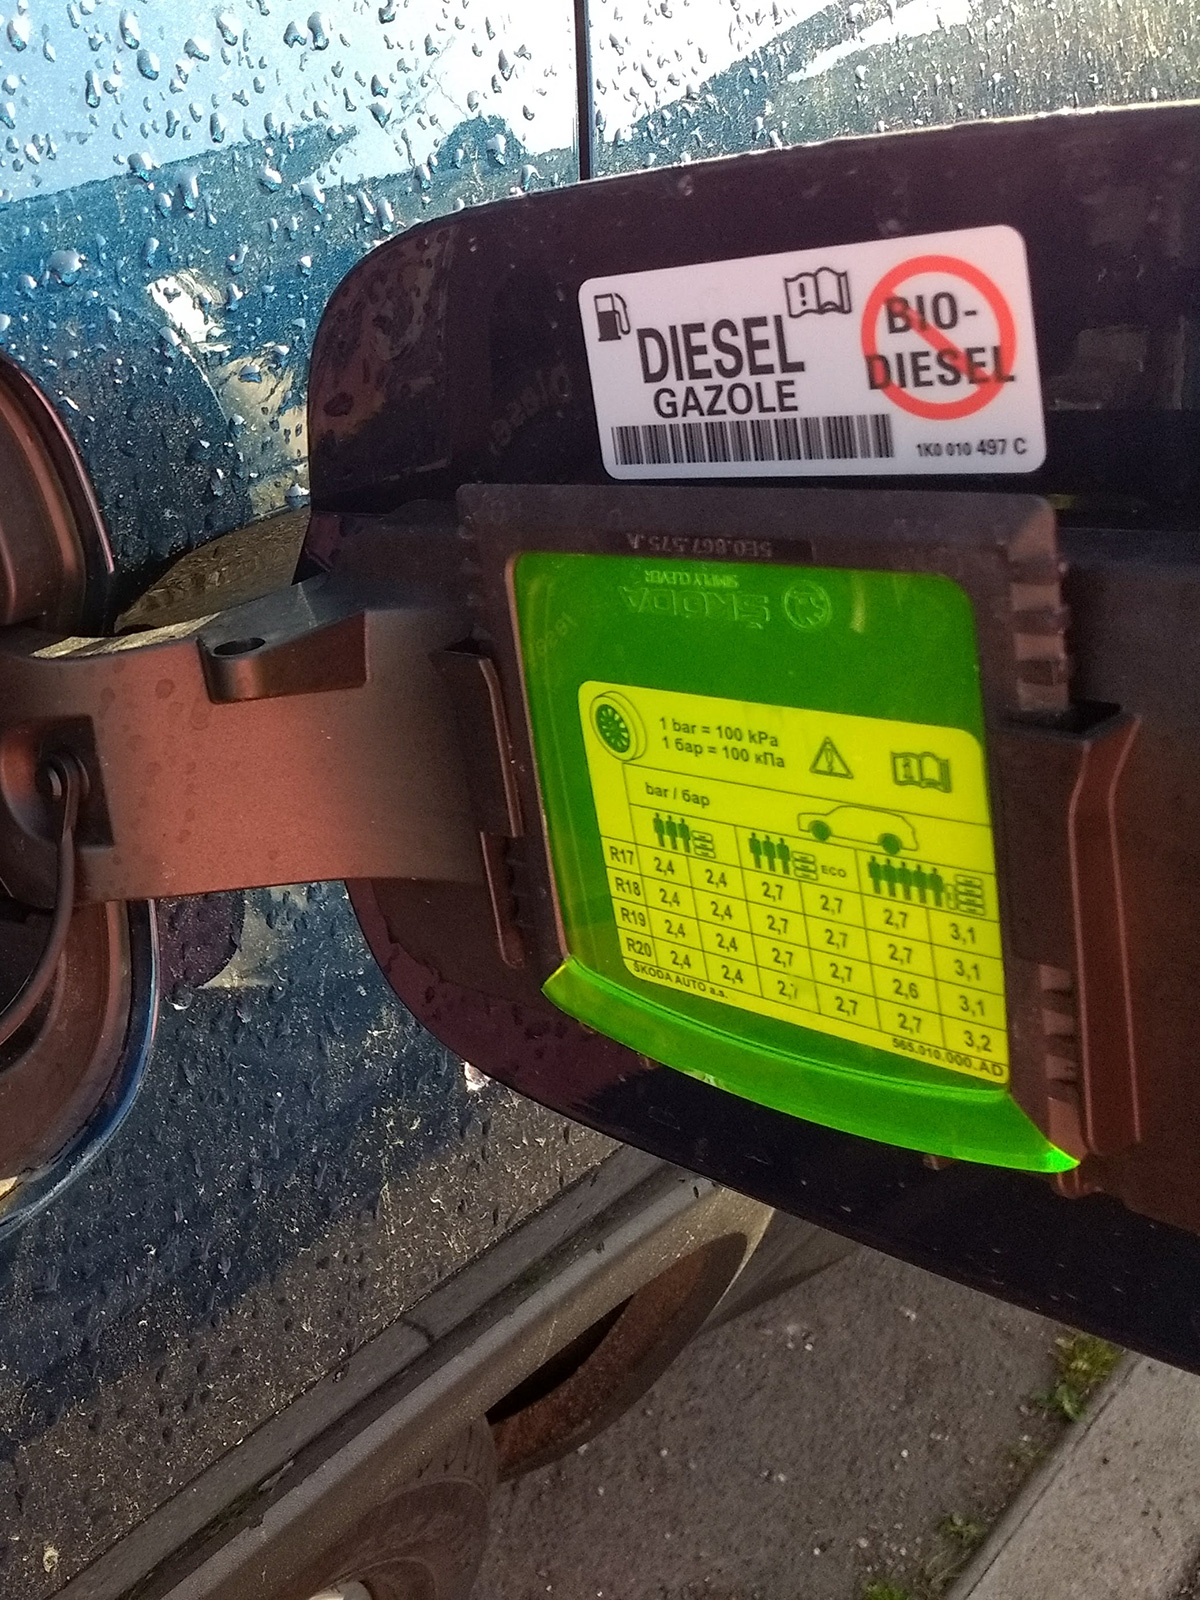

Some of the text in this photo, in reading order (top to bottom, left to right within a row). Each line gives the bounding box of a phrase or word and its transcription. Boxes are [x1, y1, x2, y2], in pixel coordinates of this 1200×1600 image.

[885, 291, 978, 335] BIO-
[636, 314, 806, 384] DIESEL
[865, 345, 1016, 390] DIESEL
[653, 380, 798, 419] GAZOLE
[916, 437, 1028, 458] 1K0 010 497 C
[672, 719, 697, 734] bar
[717, 725, 743, 742] 100
[748, 730, 779, 747] kPa
[723, 746, 749, 762] 100
[645, 782, 669, 798] bar
[821, 865, 847, 878] ECO
[609, 846, 977, 945] R17 2,4 2,4 2,7 2,7 2,7 3,1
[615, 877, 981, 982] R18 2,4 2,4 2,7 2,7 2,7 3,1
[620, 907, 986, 1017] R19 2,4 2,4 2,7 2,7 2,6 3,1
[633, 960, 672, 983] ŠKODA
[675, 976, 706, 993] AUTO
[626, 937, 652, 957] R20
[670, 950, 691, 969] 2,4
[721, 965, 744, 984] 2,4
[835, 996, 858, 1017] 2,7
[897, 1013, 922, 1034] 2,7
[964, 1030, 992, 1053] 3,2
